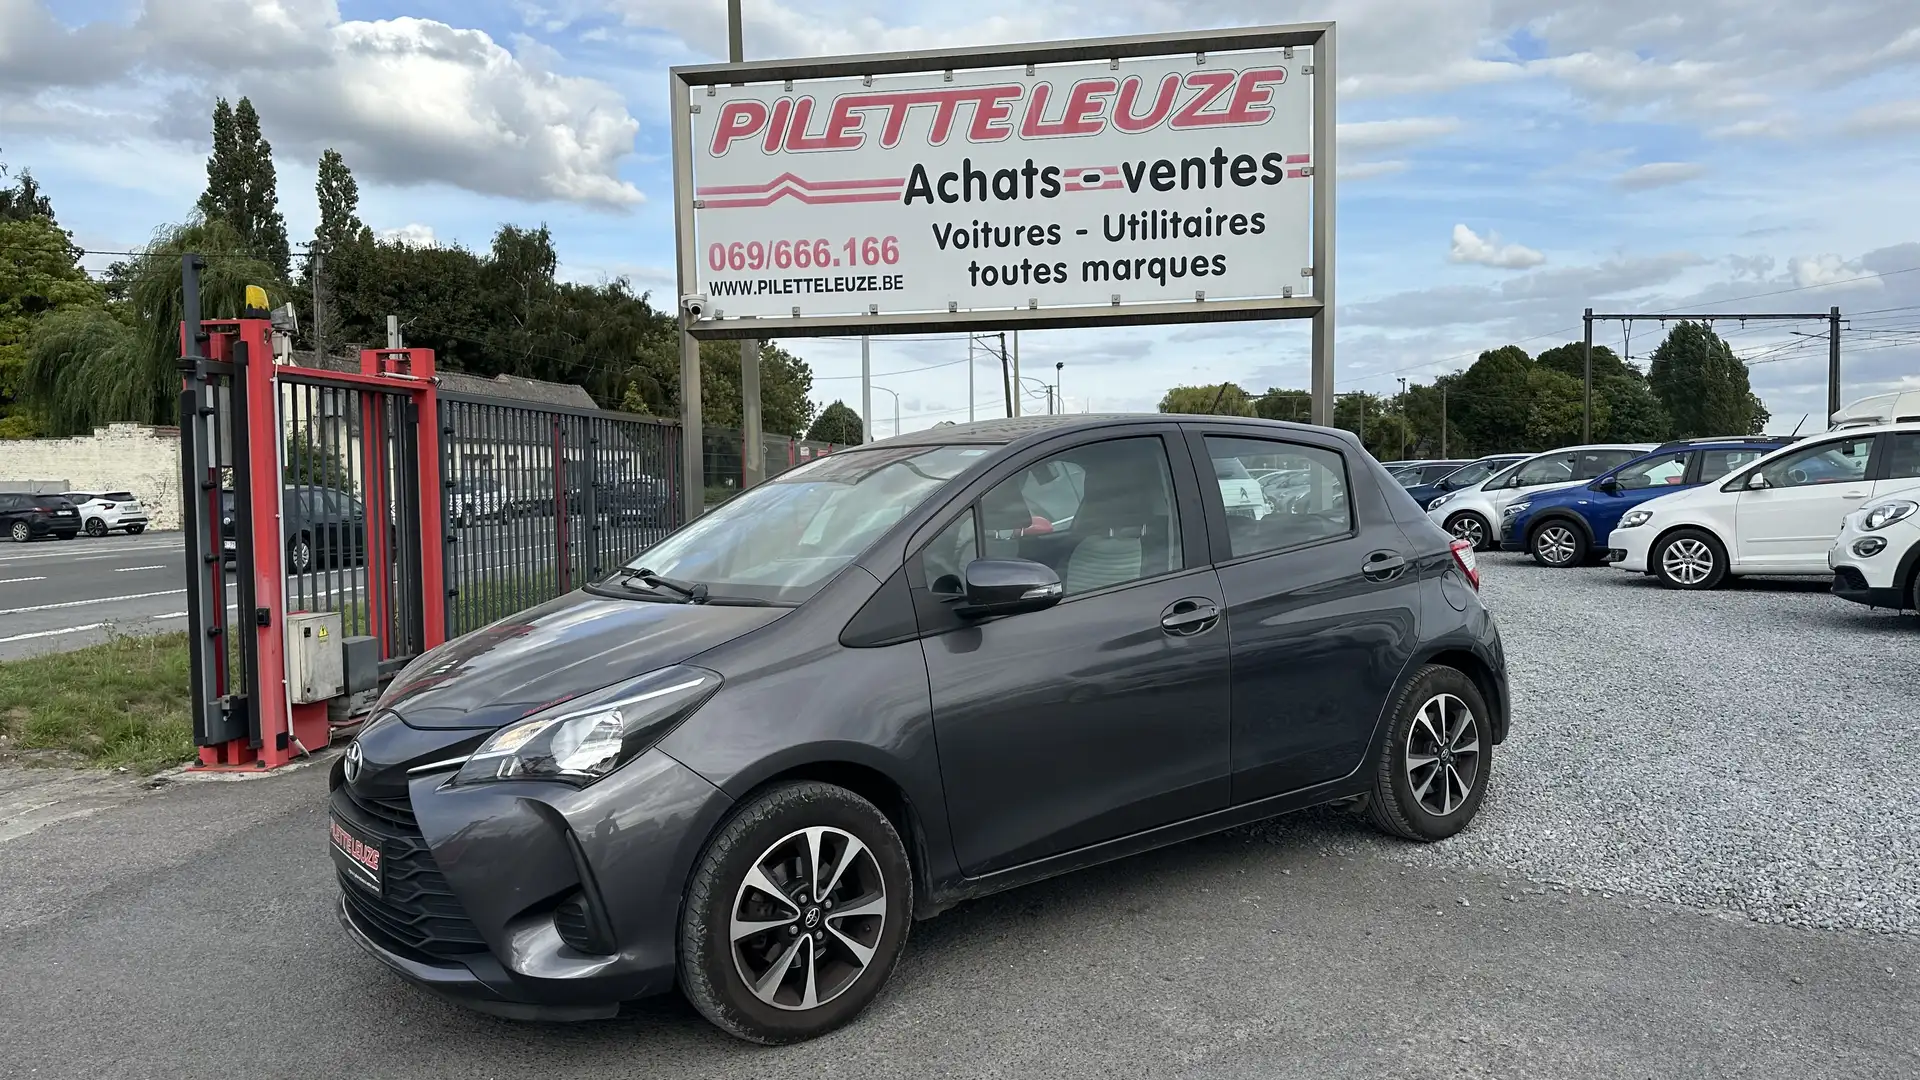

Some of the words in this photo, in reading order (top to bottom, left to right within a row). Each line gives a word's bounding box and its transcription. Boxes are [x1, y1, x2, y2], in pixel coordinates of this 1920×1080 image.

[903, 157, 1061, 206] Achats
[1122, 146, 1284, 194] ventes
[931, 219, 1062, 250] Voitures
[1103, 206, 1266, 243] Utilitaires
[708, 235, 900, 272] 069/666.166
[967, 257, 1068, 287] toutes
[1082, 253, 1227, 287] marques
[708, 274, 904, 297] WWW.PILETTELEUZE.BE
